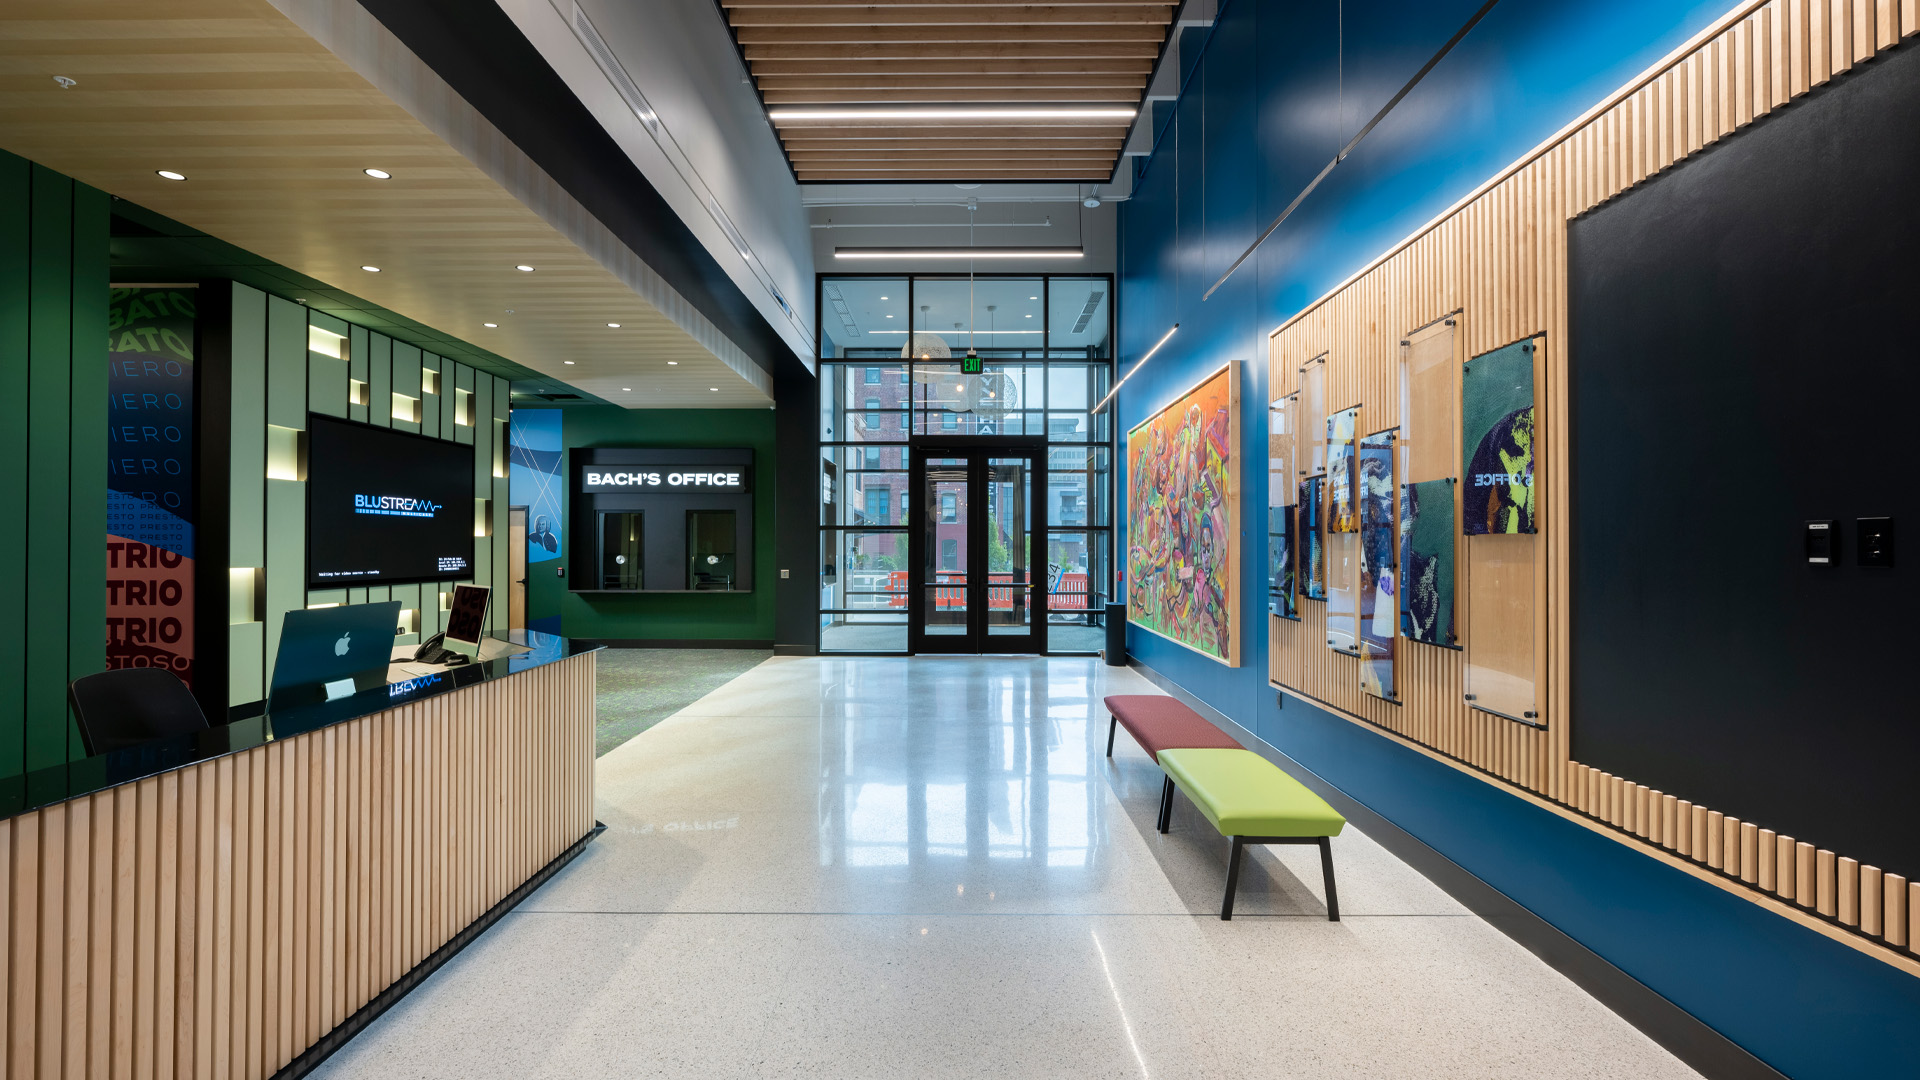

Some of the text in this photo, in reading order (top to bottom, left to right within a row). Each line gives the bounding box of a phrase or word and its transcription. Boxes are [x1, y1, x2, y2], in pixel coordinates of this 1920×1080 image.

[112, 361, 182, 377] IERO
[964, 358, 981, 372] EXIT
[111, 393, 182, 409] IERO
[111, 426, 182, 442] IERO
[110, 458, 181, 475] IERO
[587, 472, 740, 486] BACH'S OFFICE
[140, 523, 183, 531] PRESTO
[106, 579, 182, 606] TRIO
[106, 617, 182, 643] TRIO
